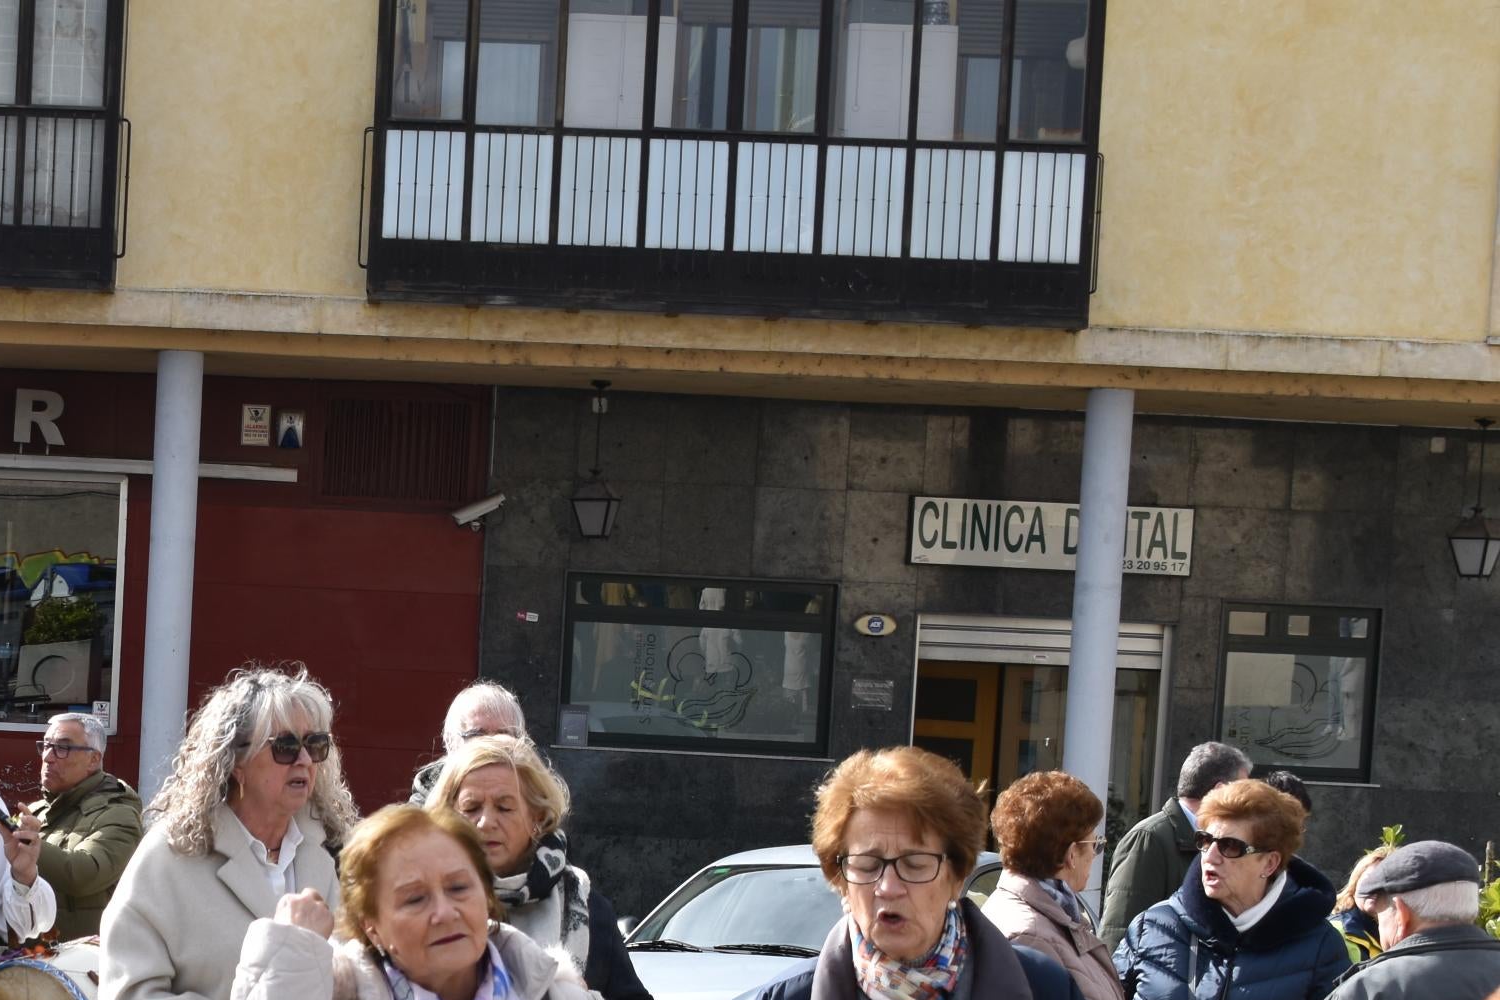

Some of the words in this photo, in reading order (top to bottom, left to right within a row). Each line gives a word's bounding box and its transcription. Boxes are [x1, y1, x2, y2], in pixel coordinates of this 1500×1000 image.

[918, 501, 1046, 554] CLINICA
[1063, 507, 1188, 560] DTAL
[1136, 560, 1151, 571] 20
[1153, 561, 1168, 572] 95
[1171, 562, 1185, 572] 17
